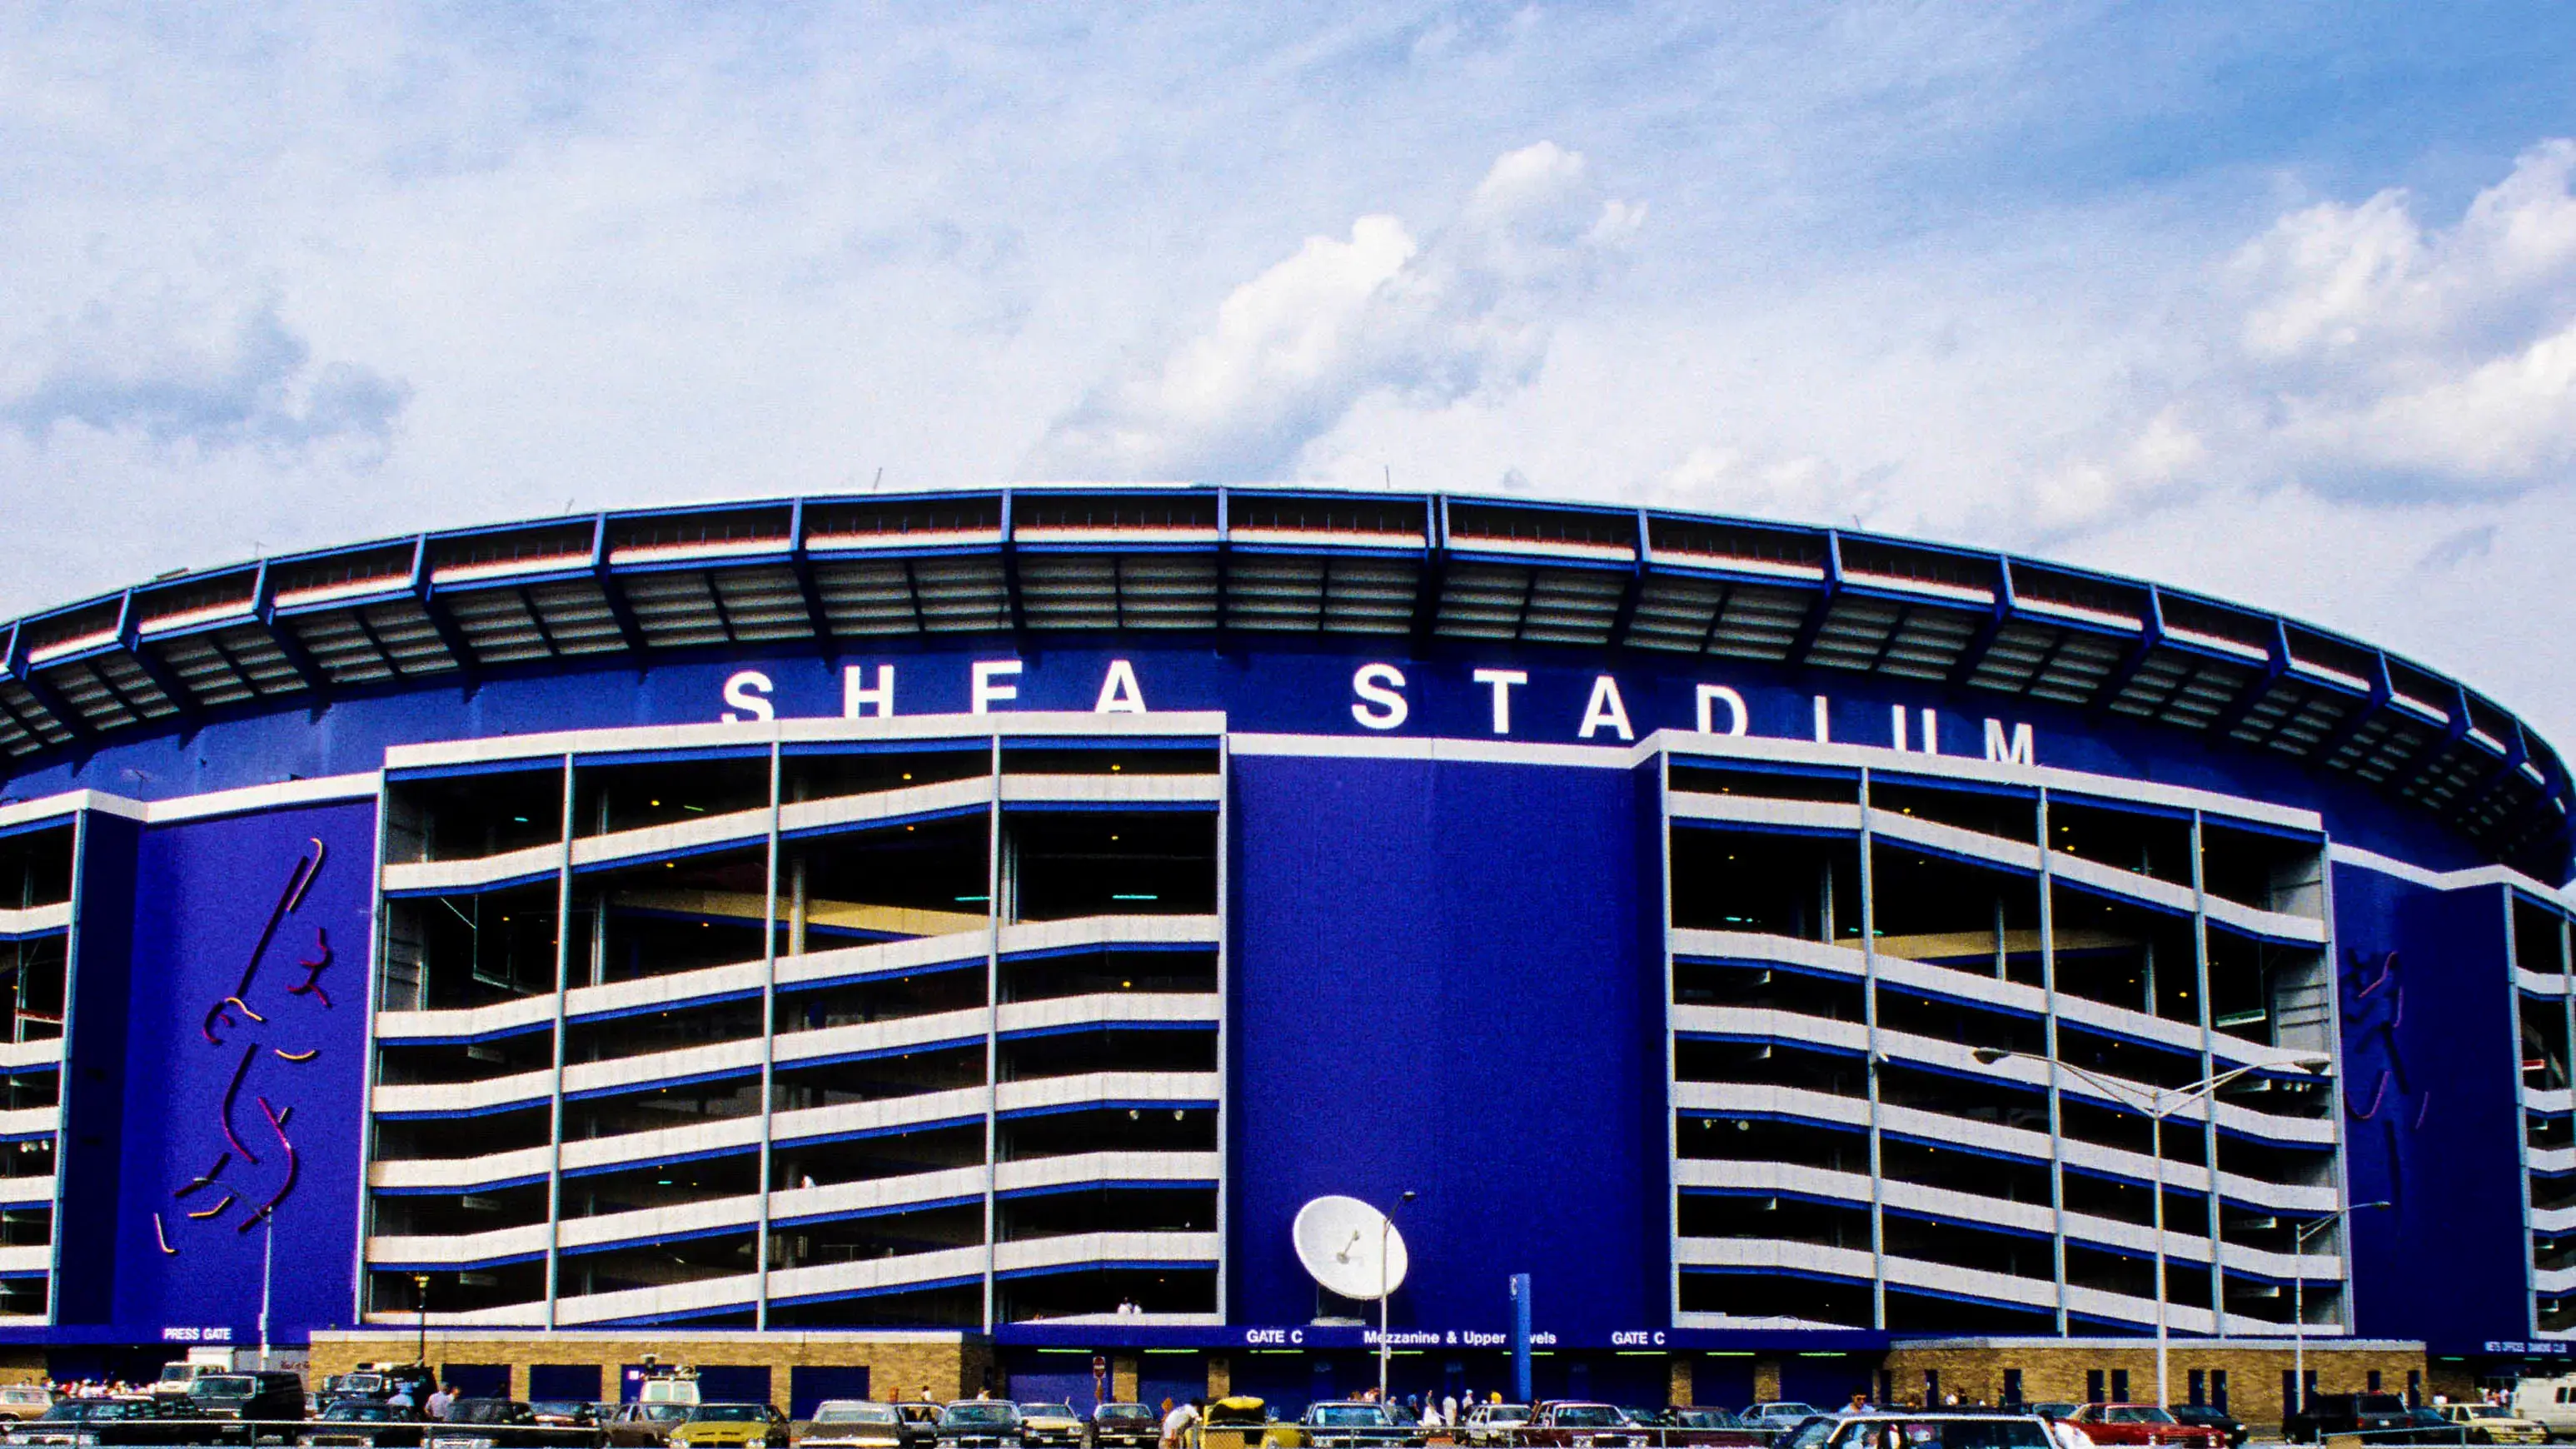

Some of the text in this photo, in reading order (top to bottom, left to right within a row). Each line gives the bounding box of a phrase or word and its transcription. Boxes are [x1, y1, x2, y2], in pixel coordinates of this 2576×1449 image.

[721, 660, 2035, 765] SHEA STADIUM
[163, 1327, 232, 1340] PRESS GATE
[1247, 1330, 1303, 1343] GATE C
[1447, 1331, 1457, 1344] &
[1464, 1331, 1506, 1347] Upper
[1530, 1332, 1557, 1345] vels
[1612, 1332, 1665, 1345] GATE C
